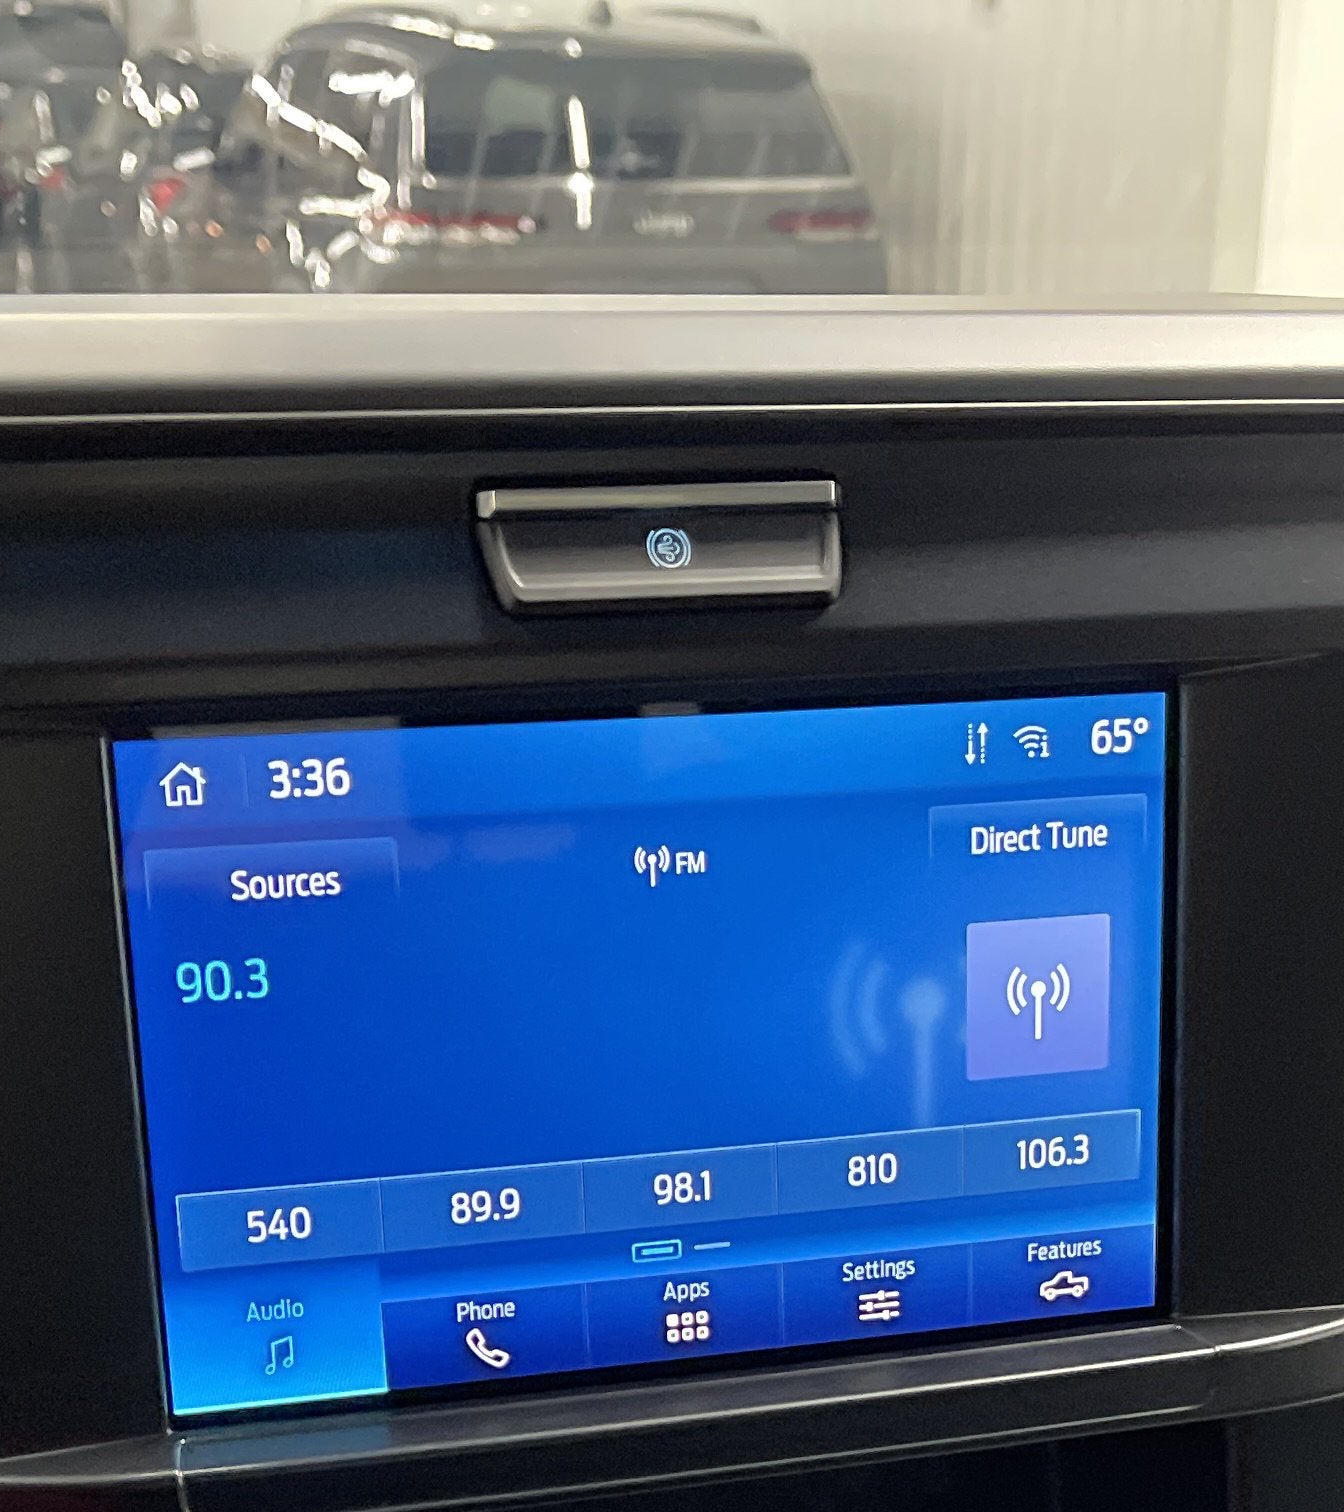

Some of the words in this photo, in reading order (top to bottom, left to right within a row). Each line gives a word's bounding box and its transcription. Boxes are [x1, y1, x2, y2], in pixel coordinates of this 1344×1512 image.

[268, 758, 350, 798] 3:36
[971, 824, 1041, 854] Direct
[1046, 822, 1108, 849] Tune
[676, 851, 705, 874] FM
[231, 870, 341, 900] Sources
[177, 958, 268, 1003] 90.3
[1017, 1134, 1089, 1169] 106.3
[848, 1153, 897, 1186] 810
[654, 1170, 710, 1205] 98.1
[452, 1188, 520, 1224] 89.9
[247, 1207, 311, 1242] 540
[1028, 1240, 1101, 1261] Features
[843, 1260, 915, 1281] Settings
[664, 1282, 709, 1303] Apps
[247, 1299, 303, 1322] Audio
[457, 1301, 515, 1322] Phone
